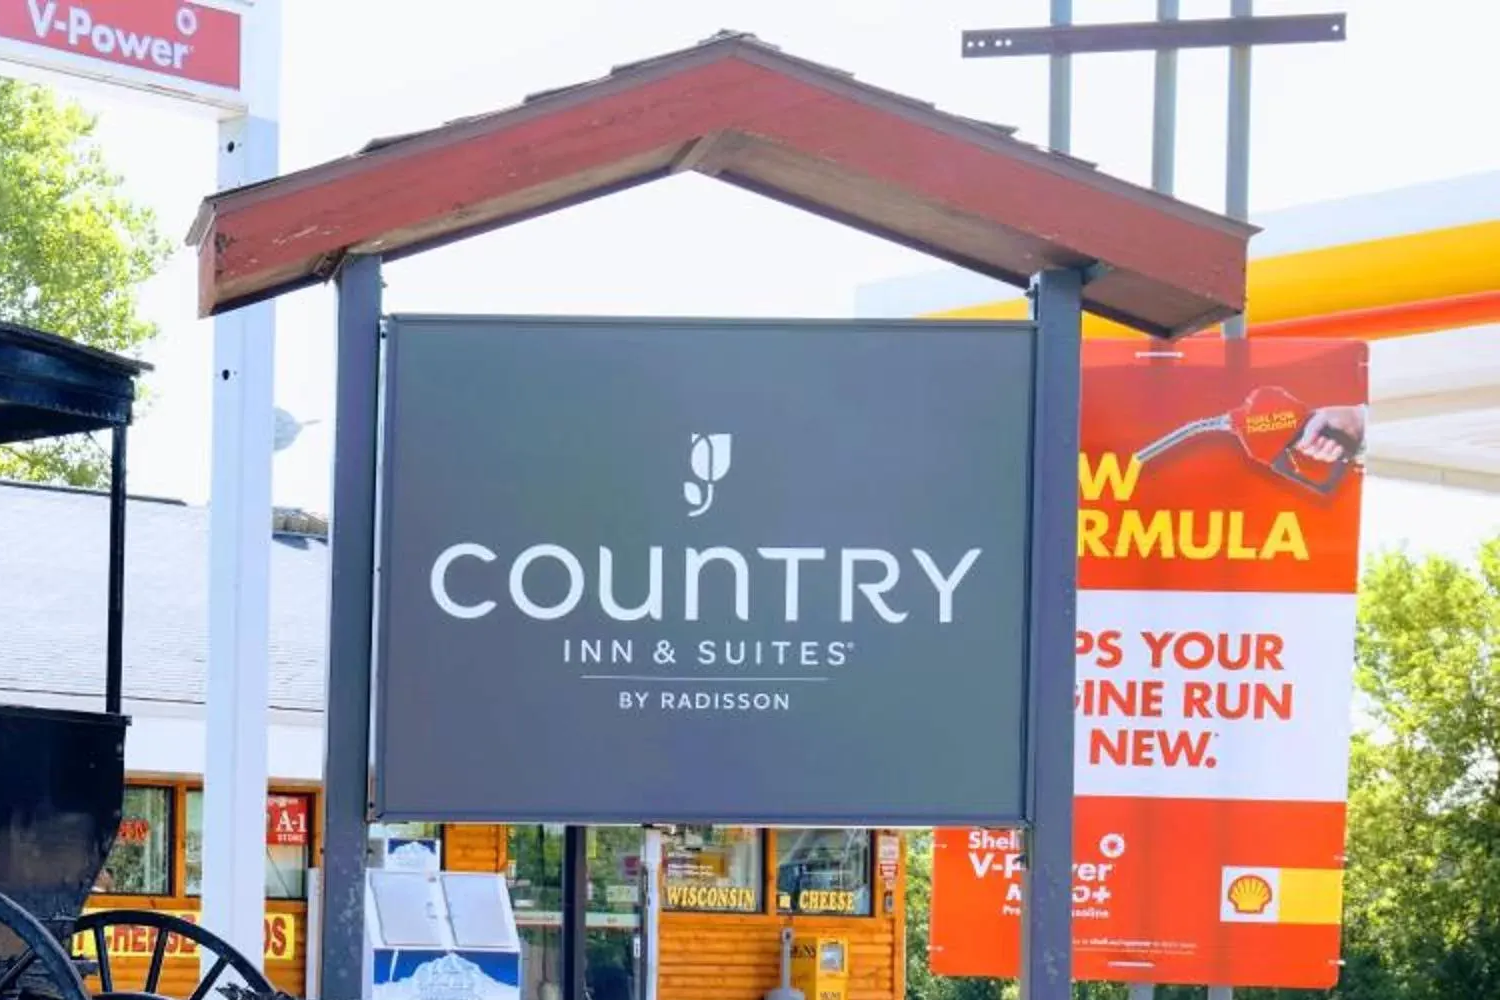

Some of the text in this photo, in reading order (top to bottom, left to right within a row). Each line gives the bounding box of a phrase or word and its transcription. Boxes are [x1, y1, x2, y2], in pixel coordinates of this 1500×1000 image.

[27, 0, 190, 69] V-Power
[1077, 509, 1310, 560] RMULA
[430, 543, 983, 624] COUNTRY
[563, 639, 847, 666] INN & SUITES
[1140, 631, 1284, 670] YOUR
[619, 692, 790, 711] BY RADISSON
[1073, 679, 1294, 721] INE RUN
[1088, 729, 1218, 768] NEW.
[275, 809, 308, 833] A-1
[667, 886, 756, 912] WISCONSIN
[799, 889, 855, 912] CHEESE
